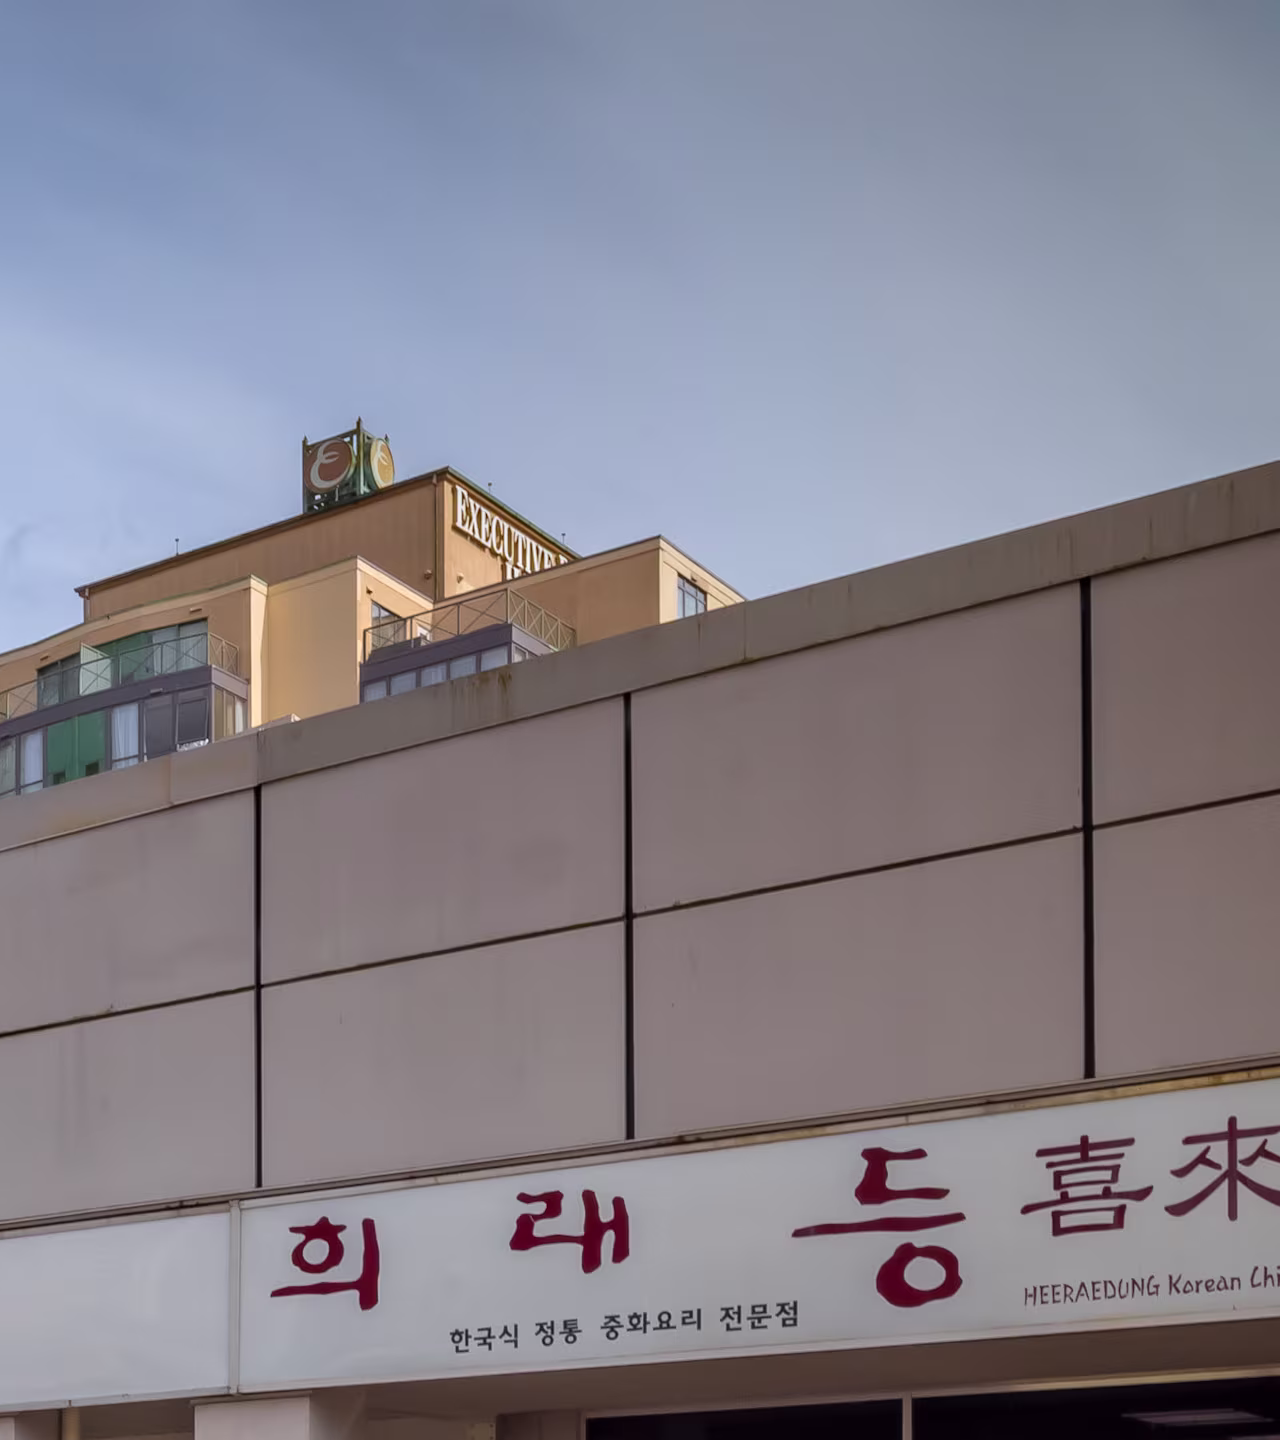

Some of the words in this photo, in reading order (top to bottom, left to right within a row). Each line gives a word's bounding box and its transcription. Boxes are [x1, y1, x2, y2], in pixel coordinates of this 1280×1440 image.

[455, 485, 556, 574] EXECUTIVE
[1024, 1275, 1160, 1307] HEERAEDUNG
[1168, 1273, 1241, 1296] Korean
[449, 1323, 519, 1354] 한국식
[534, 1318, 583, 1346] 정통
[600, 1308, 703, 1341] 중화요리
[719, 1300, 799, 1332] 전문점
